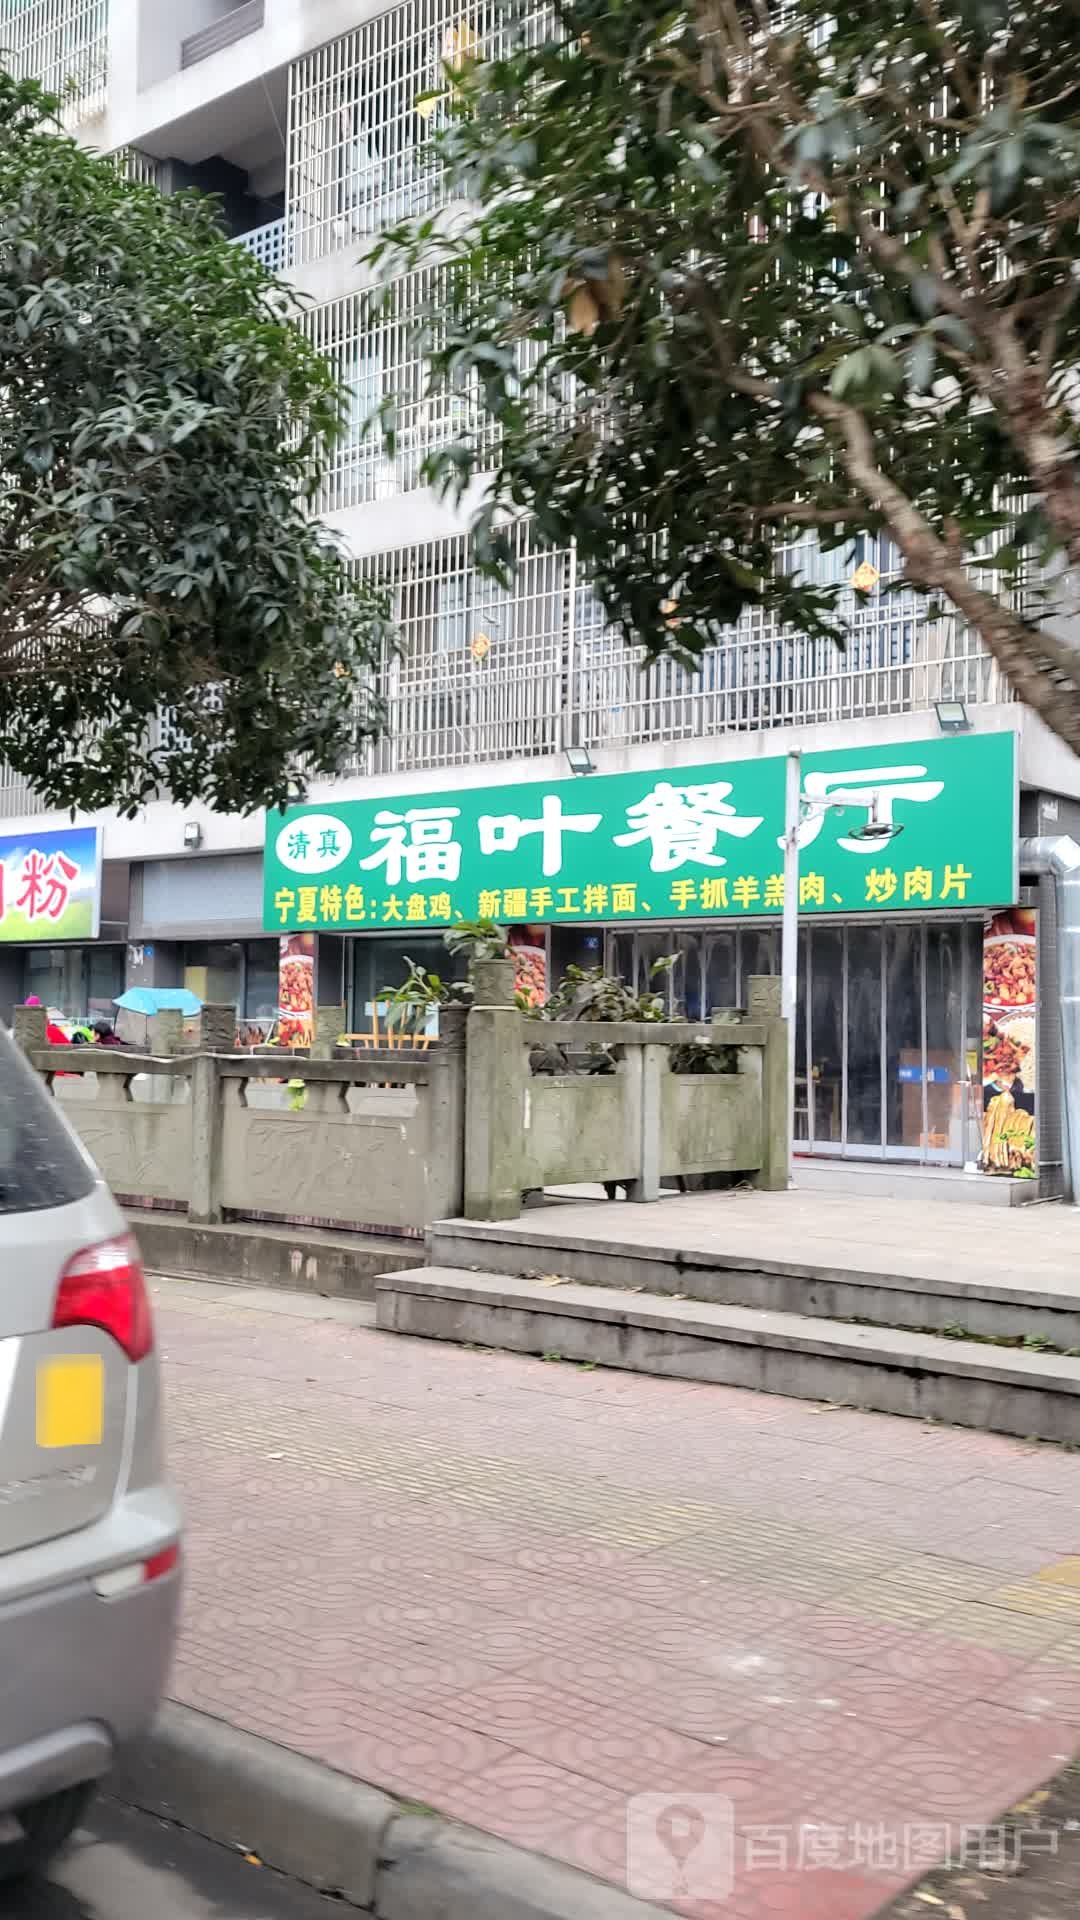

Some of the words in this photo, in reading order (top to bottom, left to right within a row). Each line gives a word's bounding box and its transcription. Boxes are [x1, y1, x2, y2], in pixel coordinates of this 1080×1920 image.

[287, 828, 341, 860] 清真
[359, 764, 945, 887] 福叶餐厅
[0, 853, 78, 919] 粉
